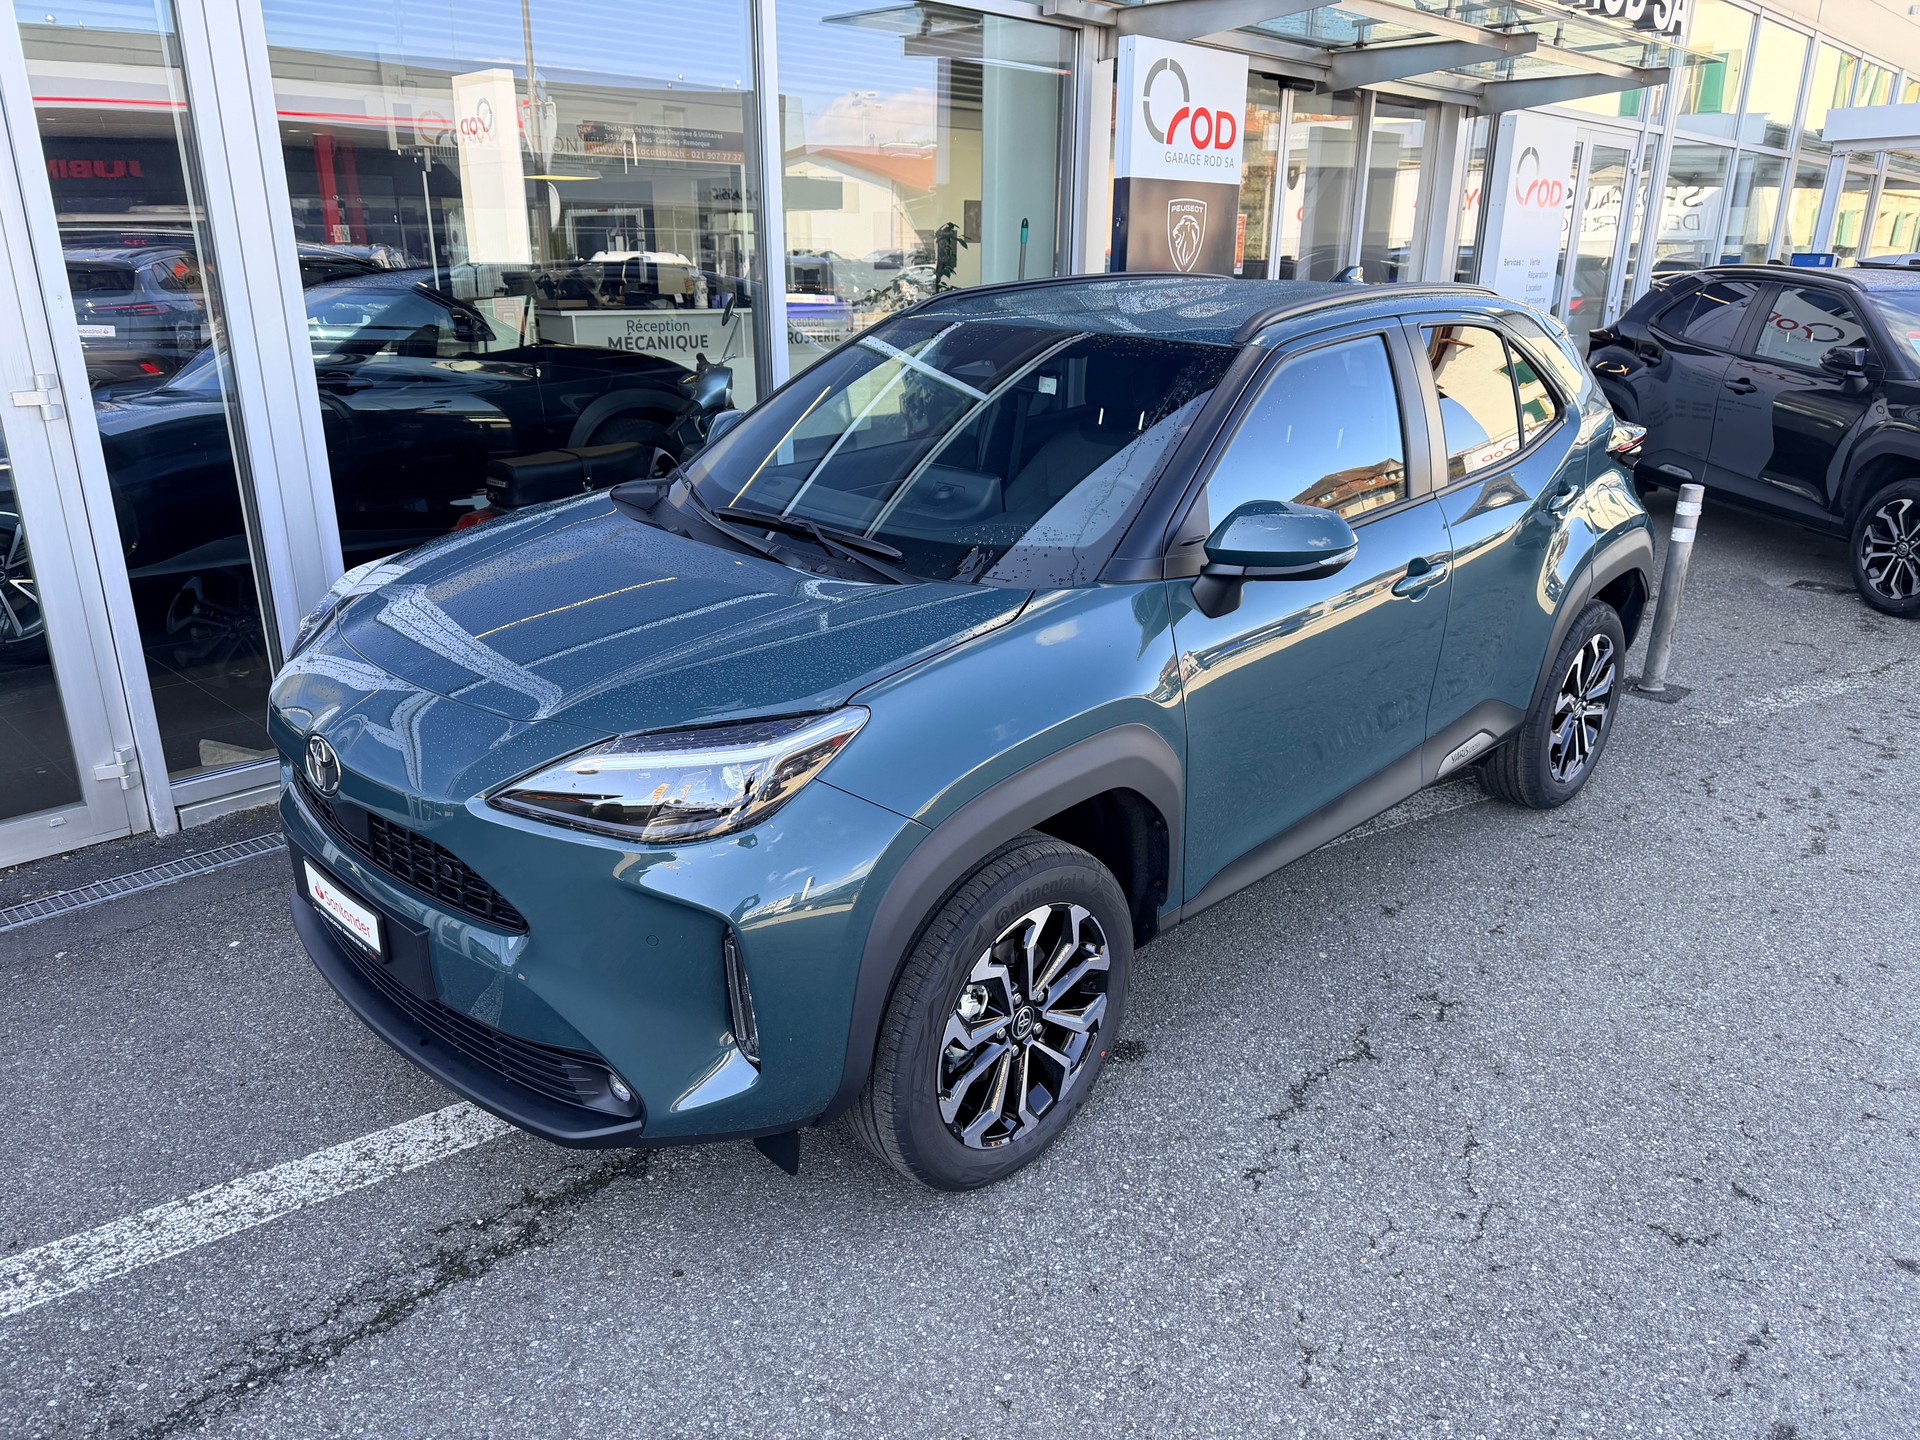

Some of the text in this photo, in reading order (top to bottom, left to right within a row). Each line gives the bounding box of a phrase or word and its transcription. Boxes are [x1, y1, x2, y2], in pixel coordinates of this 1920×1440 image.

[604, 124, 618, 132] Tous
[698, 131, 724, 140] Utilitaires
[655, 137, 681, 147] Camping
[683, 139, 711, 148] Remorque
[691, 151, 704, 159] 021
[1165, 151, 1235, 169] GARAGE ROD SA
[1171, 204, 1204, 213] PEUGEOT
[1526, 283, 1542, 292] Location
[626, 319, 690, 336] Réception
[608, 333, 709, 351] MÉCANIQUE
[994, 873, 1077, 930] Continental
[324, 890, 371, 937] Santander
